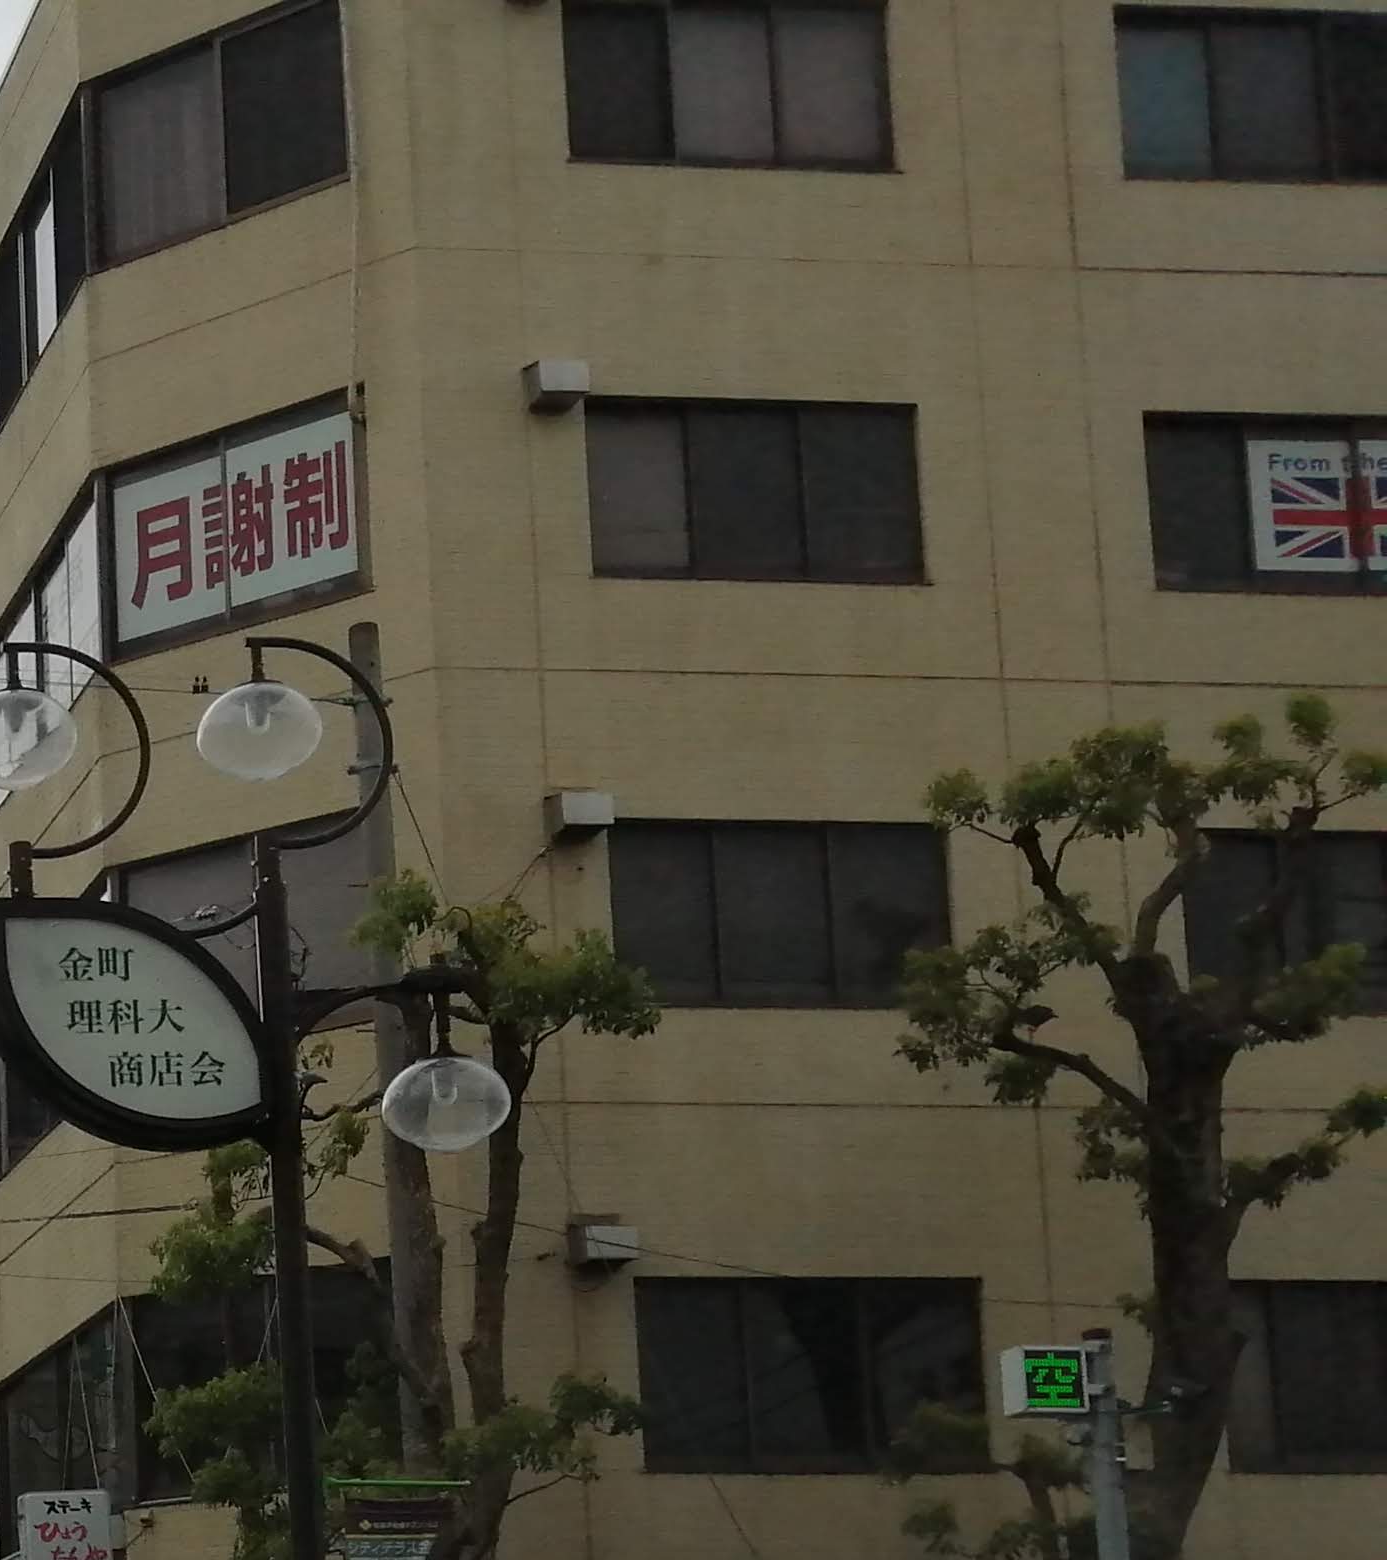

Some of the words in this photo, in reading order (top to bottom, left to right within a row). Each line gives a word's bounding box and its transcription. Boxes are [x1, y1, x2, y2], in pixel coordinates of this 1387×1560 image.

[1268, 453, 1329, 472] From
[131, 440, 350, 610] 月謝制
[58, 947, 134, 982] 金町
[67, 999, 185, 1034] 理科大
[108, 1051, 225, 1087] 商店会
[1024, 1352, 1081, 1408] 空
[43, 1498, 92, 1514] ステーキ
[34, 1522, 87, 1542] ひょう
